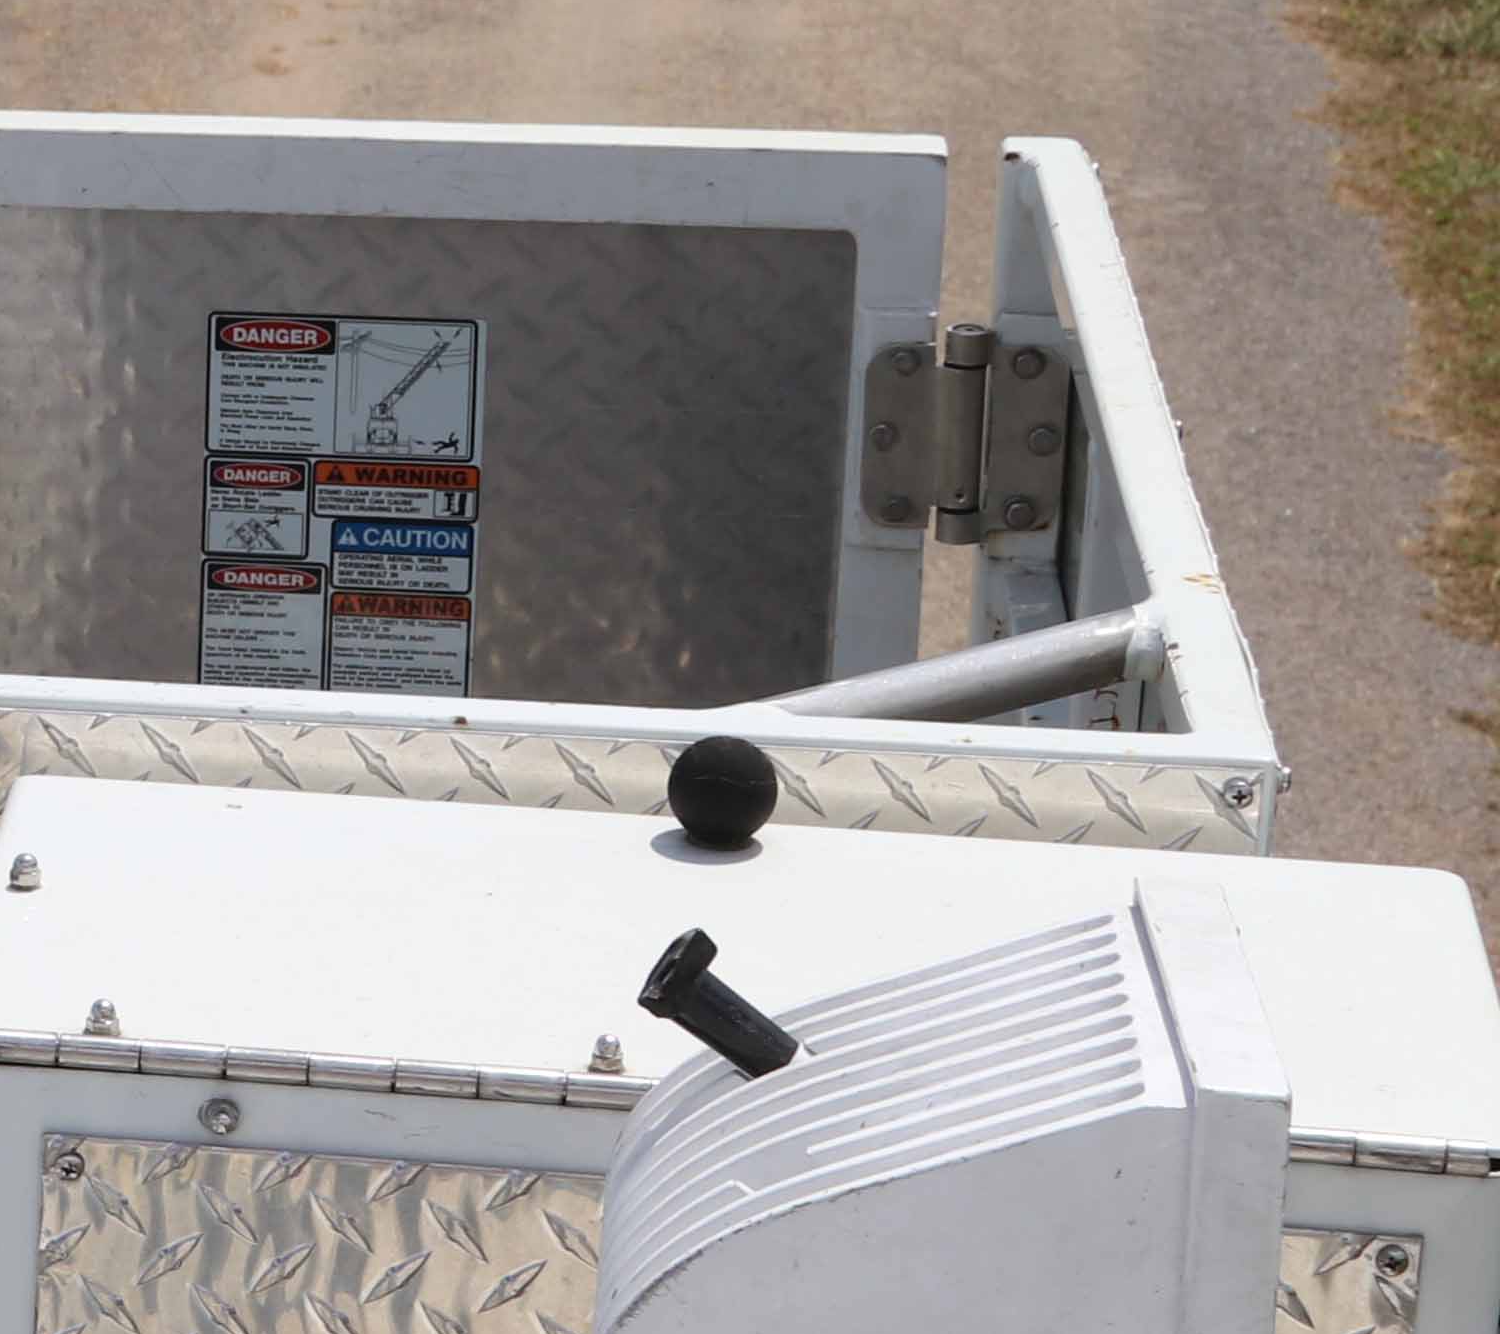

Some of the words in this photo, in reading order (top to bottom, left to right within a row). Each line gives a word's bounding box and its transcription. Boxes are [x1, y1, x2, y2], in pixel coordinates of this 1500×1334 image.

[233, 328, 317, 344] DANGER
[224, 469, 290, 483] DANGER
[354, 467, 467, 485] WARNING
[363, 528, 467, 549] CAUTION
[223, 571, 304, 587] DANGER
[359, 596, 464, 616] WARNING
